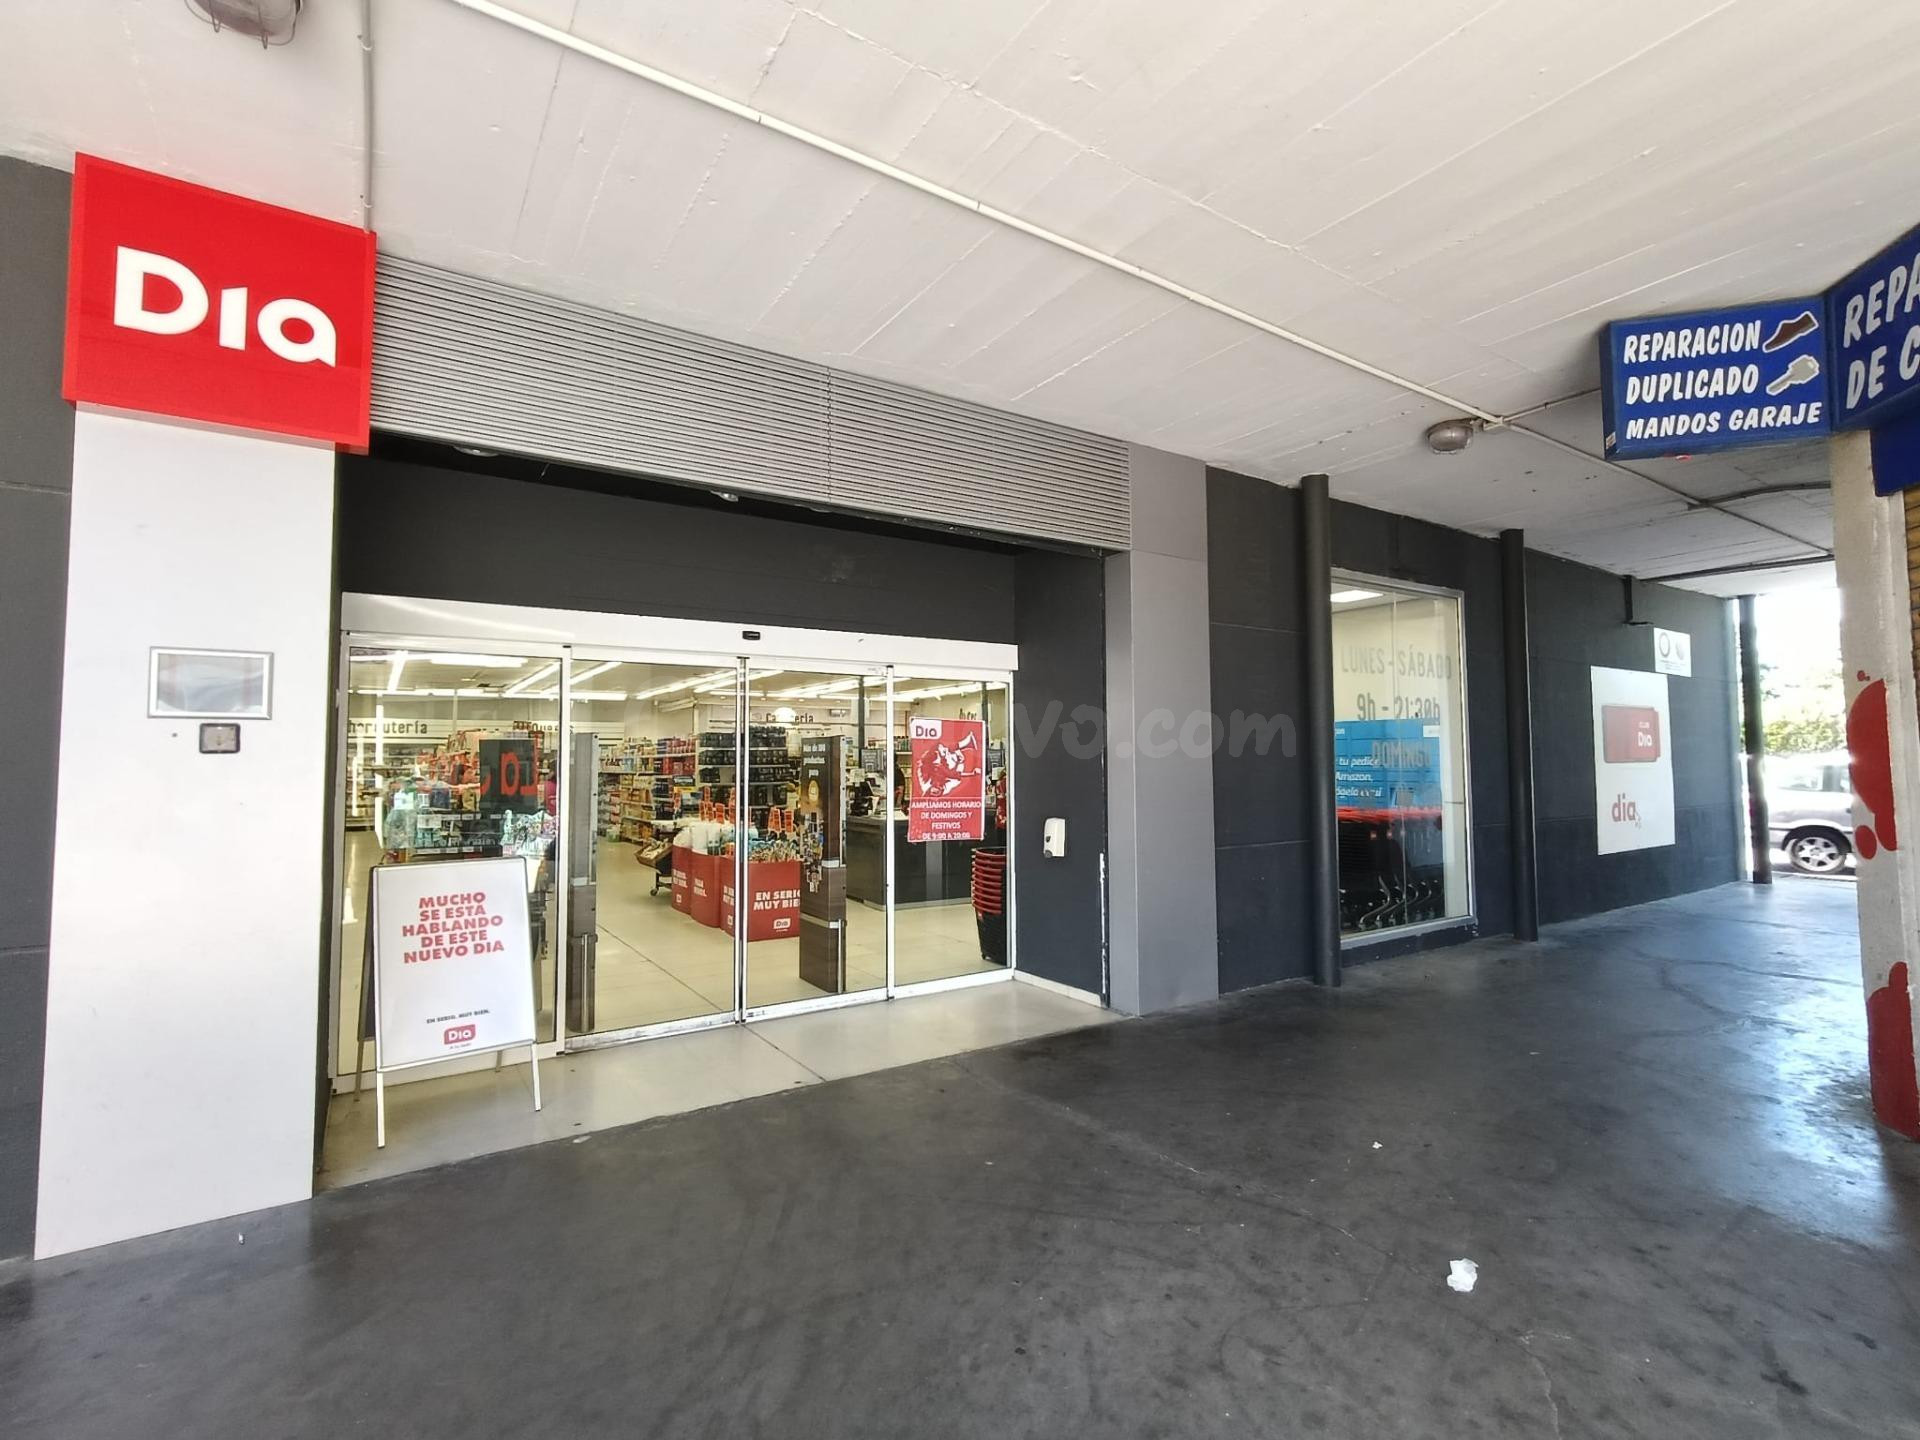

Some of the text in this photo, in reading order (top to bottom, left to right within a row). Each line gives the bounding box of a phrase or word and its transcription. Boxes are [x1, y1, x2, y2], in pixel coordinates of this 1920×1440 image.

[1623, 320, 1761, 364] REPARACION
[1625, 364, 1760, 405] DUPLICADO
[1845, 344, 1888, 410] DE
[1626, 401, 1823, 440] MANDOS GARAJE
[1341, 646, 1385, 674] LUNES
[1397, 643, 1453, 680] SÁBADO
[911, 801, 951, 809] AMPLIAMOS
[921, 811, 929, 819] DE
[930, 811, 967, 819] DOMINGOS
[931, 821, 961, 830] FESTIVOS
[922, 832, 930, 840] DE
[418, 892, 486, 909] MUCHO
[754, 899, 800, 910] MUY BIE
[756, 892, 771, 901] EN
[420, 905, 486, 922] SE ESTA
[402, 915, 503, 937] HABLANDO
[421, 930, 488, 948] DE ESTE
[403, 940, 505, 964] NUEVO DIA
